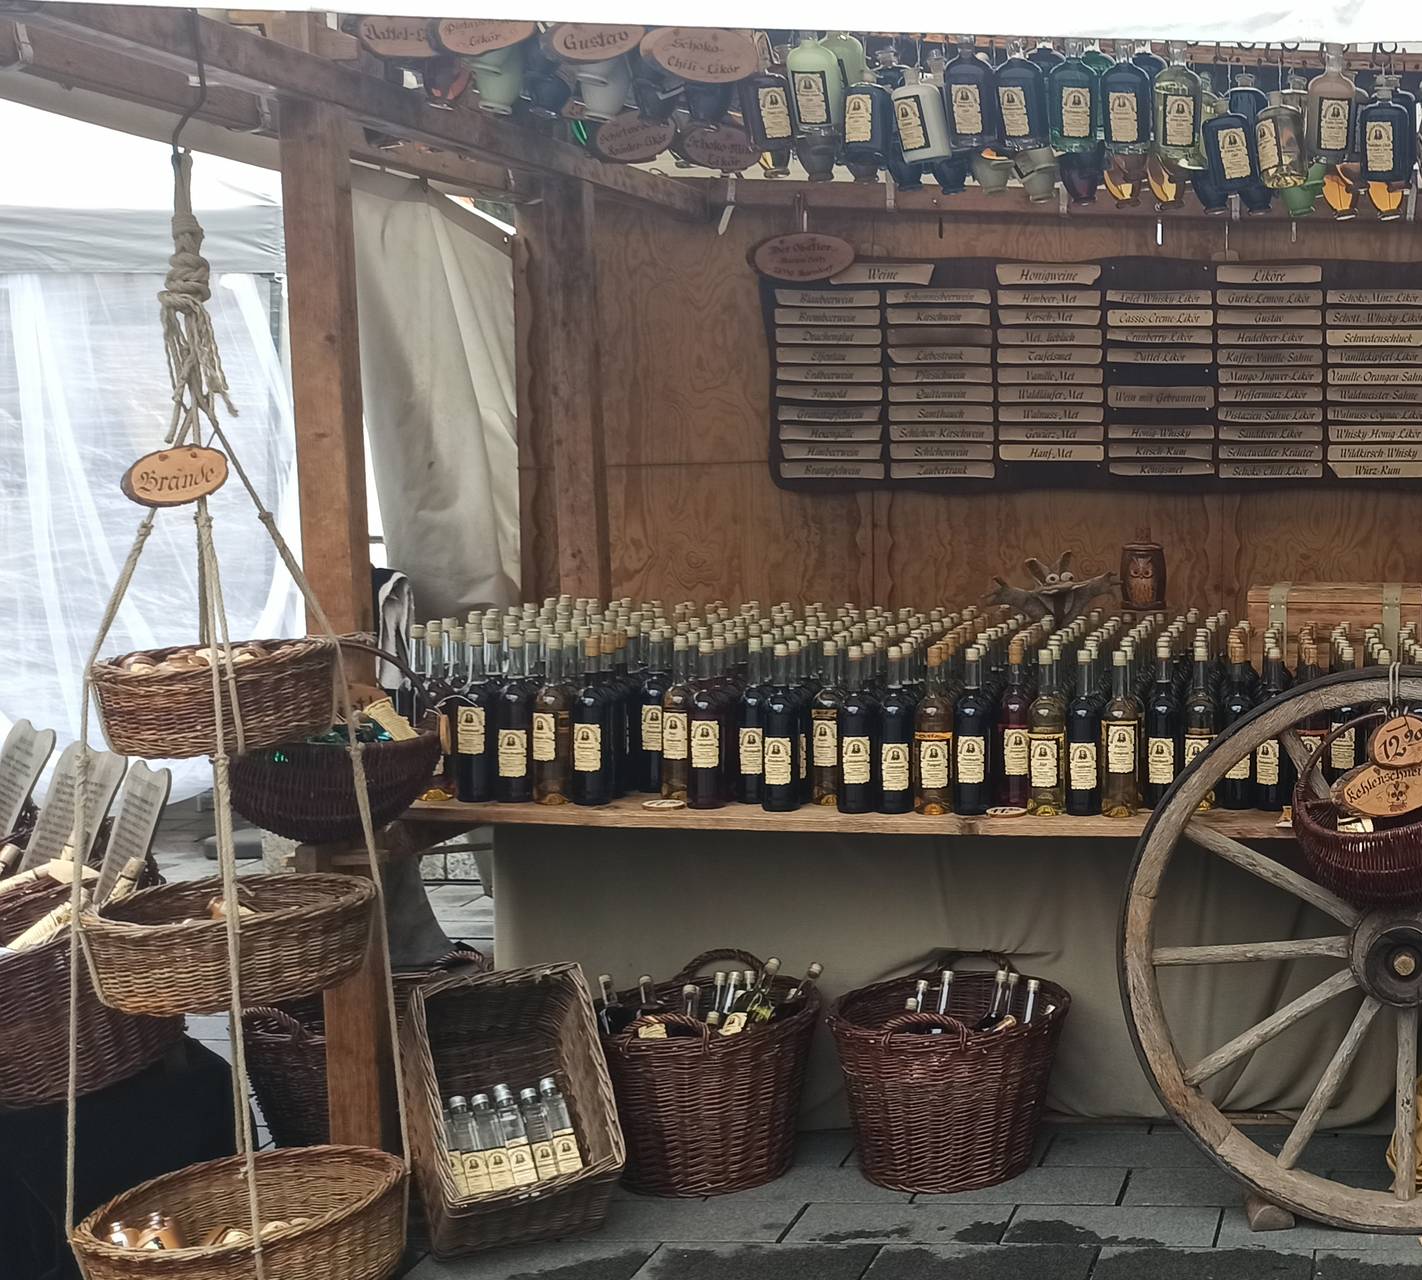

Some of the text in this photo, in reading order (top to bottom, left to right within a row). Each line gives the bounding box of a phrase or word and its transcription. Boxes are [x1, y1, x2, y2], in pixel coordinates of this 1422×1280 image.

[563, 31, 630, 51] Gustav
[868, 268, 898, 281] Weine
[1020, 269, 1078, 284] Honigweine
[1252, 269, 1286, 283] Liköre
[139, 465, 215, 492] Brände
